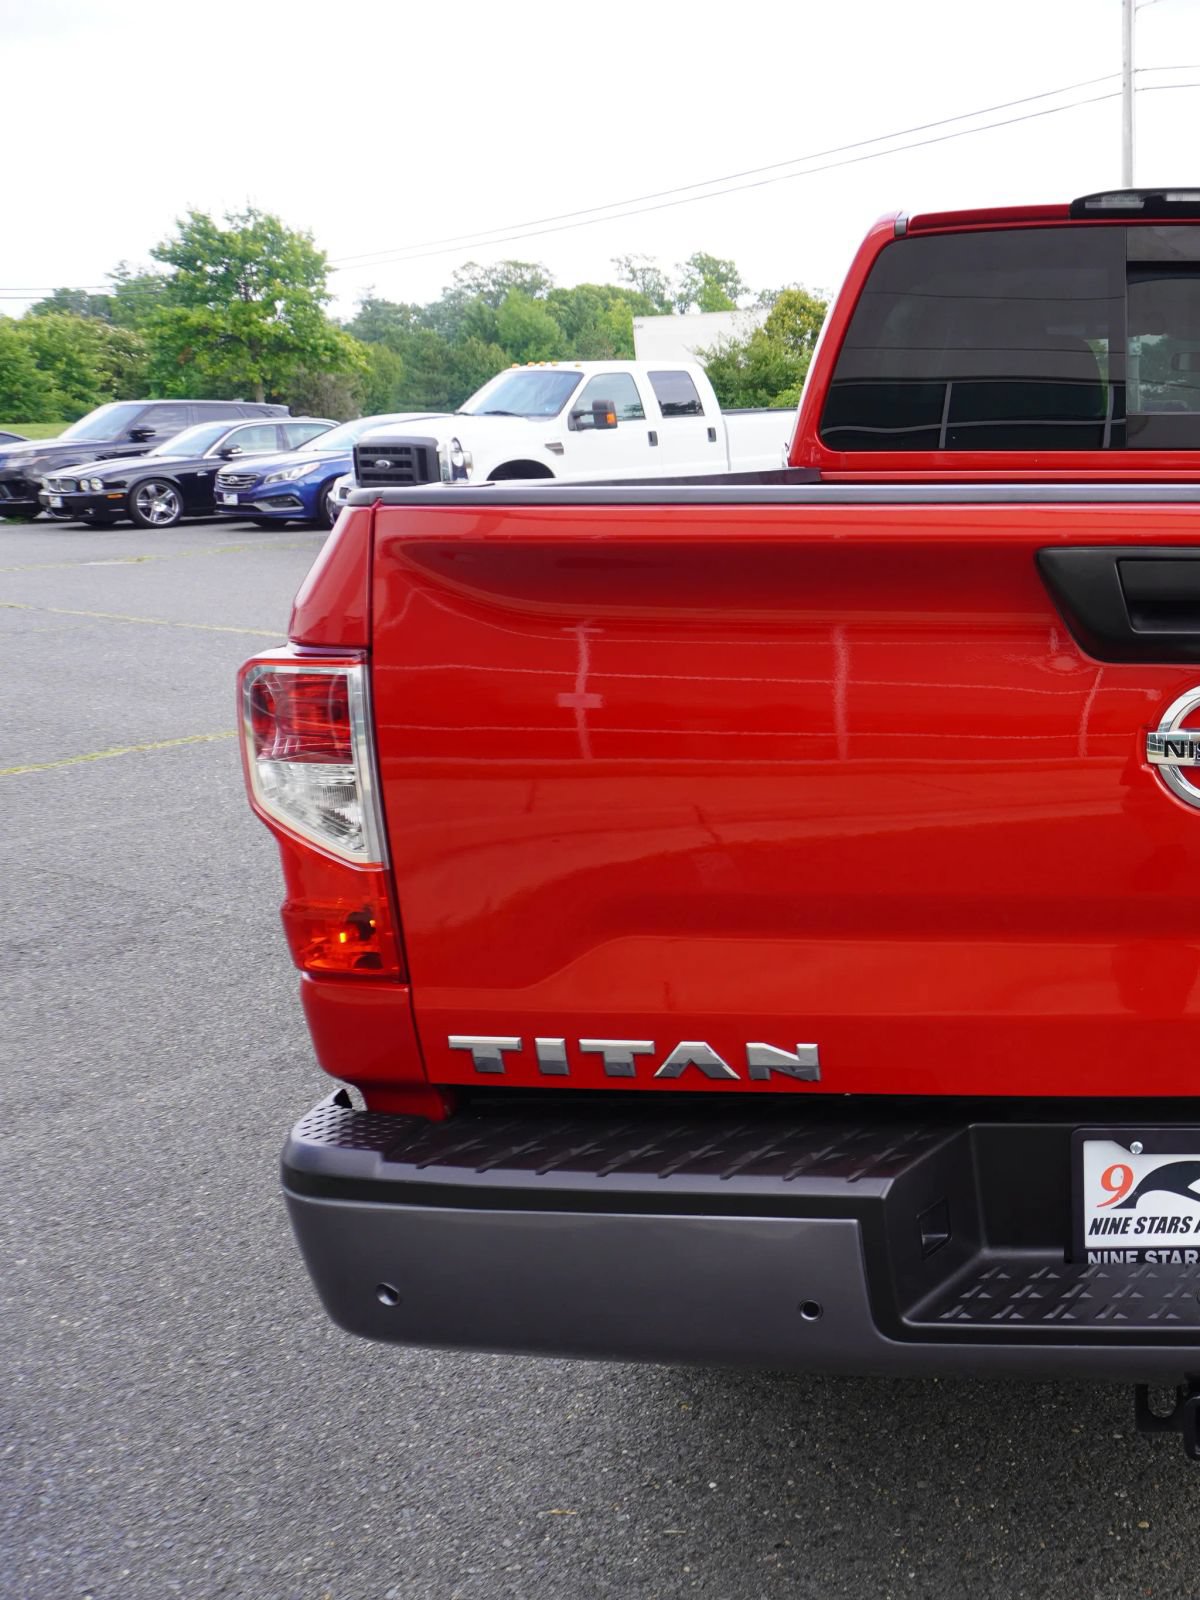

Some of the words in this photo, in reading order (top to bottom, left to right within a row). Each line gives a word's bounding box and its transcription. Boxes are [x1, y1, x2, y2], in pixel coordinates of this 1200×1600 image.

[447, 1035, 822, 1082] TITAN
[1096, 1164, 1134, 1208] 9
[1088, 1216, 1133, 1236] NINE
[1134, 1216, 1193, 1234] STARS
[1087, 1250, 1139, 1264] NINE
